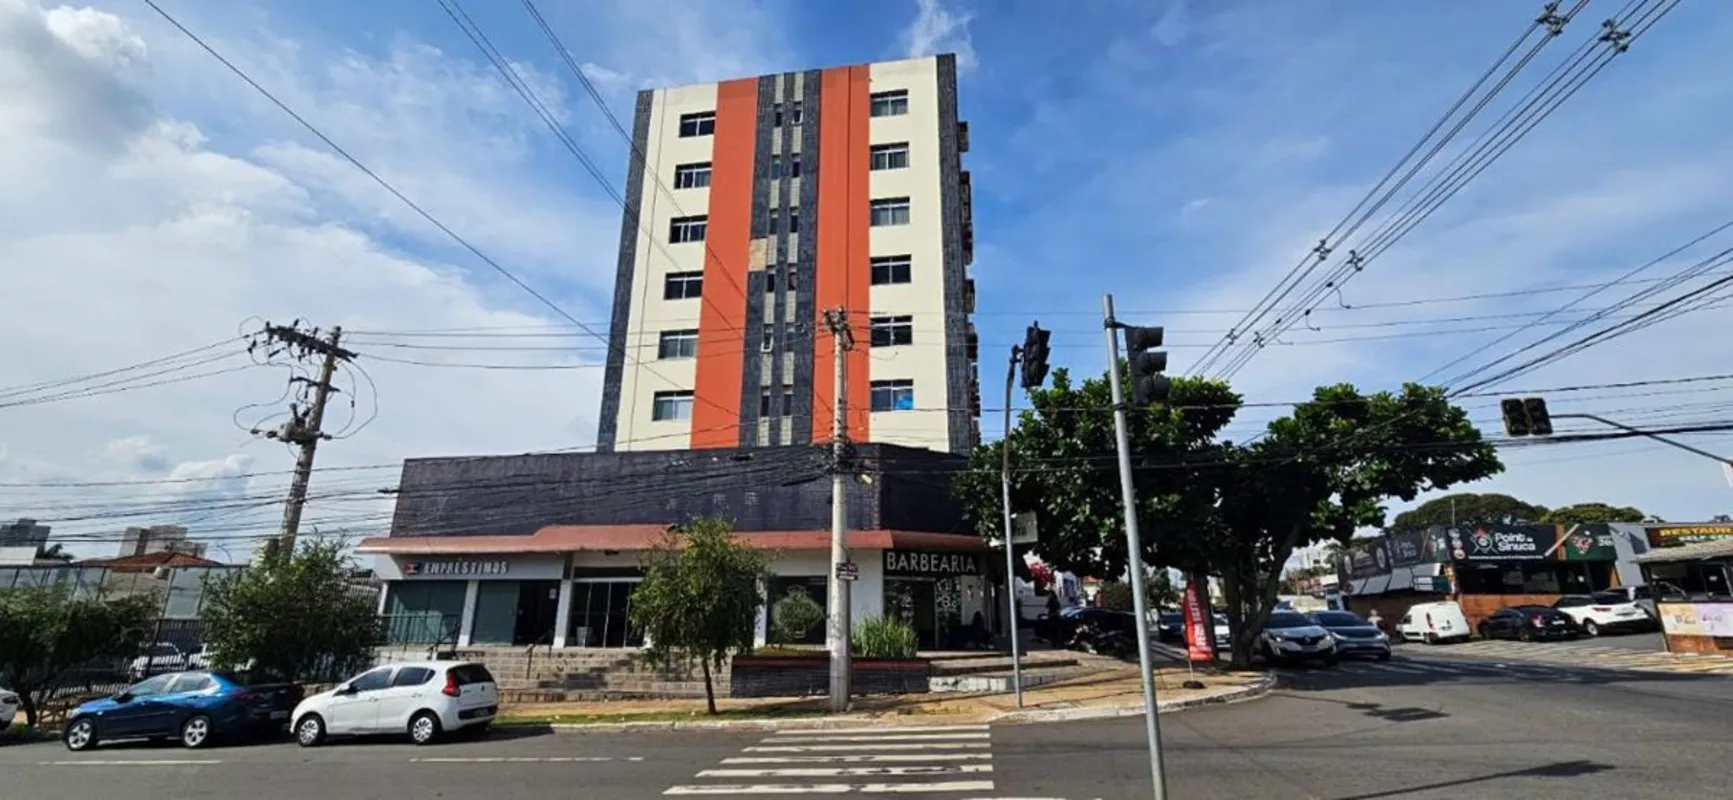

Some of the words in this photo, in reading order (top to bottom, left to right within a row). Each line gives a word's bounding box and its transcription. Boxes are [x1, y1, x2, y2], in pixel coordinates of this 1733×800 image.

[1495, 532, 1525, 543] Point
[1498, 542, 1536, 552] Sinuca
[886, 552, 976, 573] BARBEARIA
